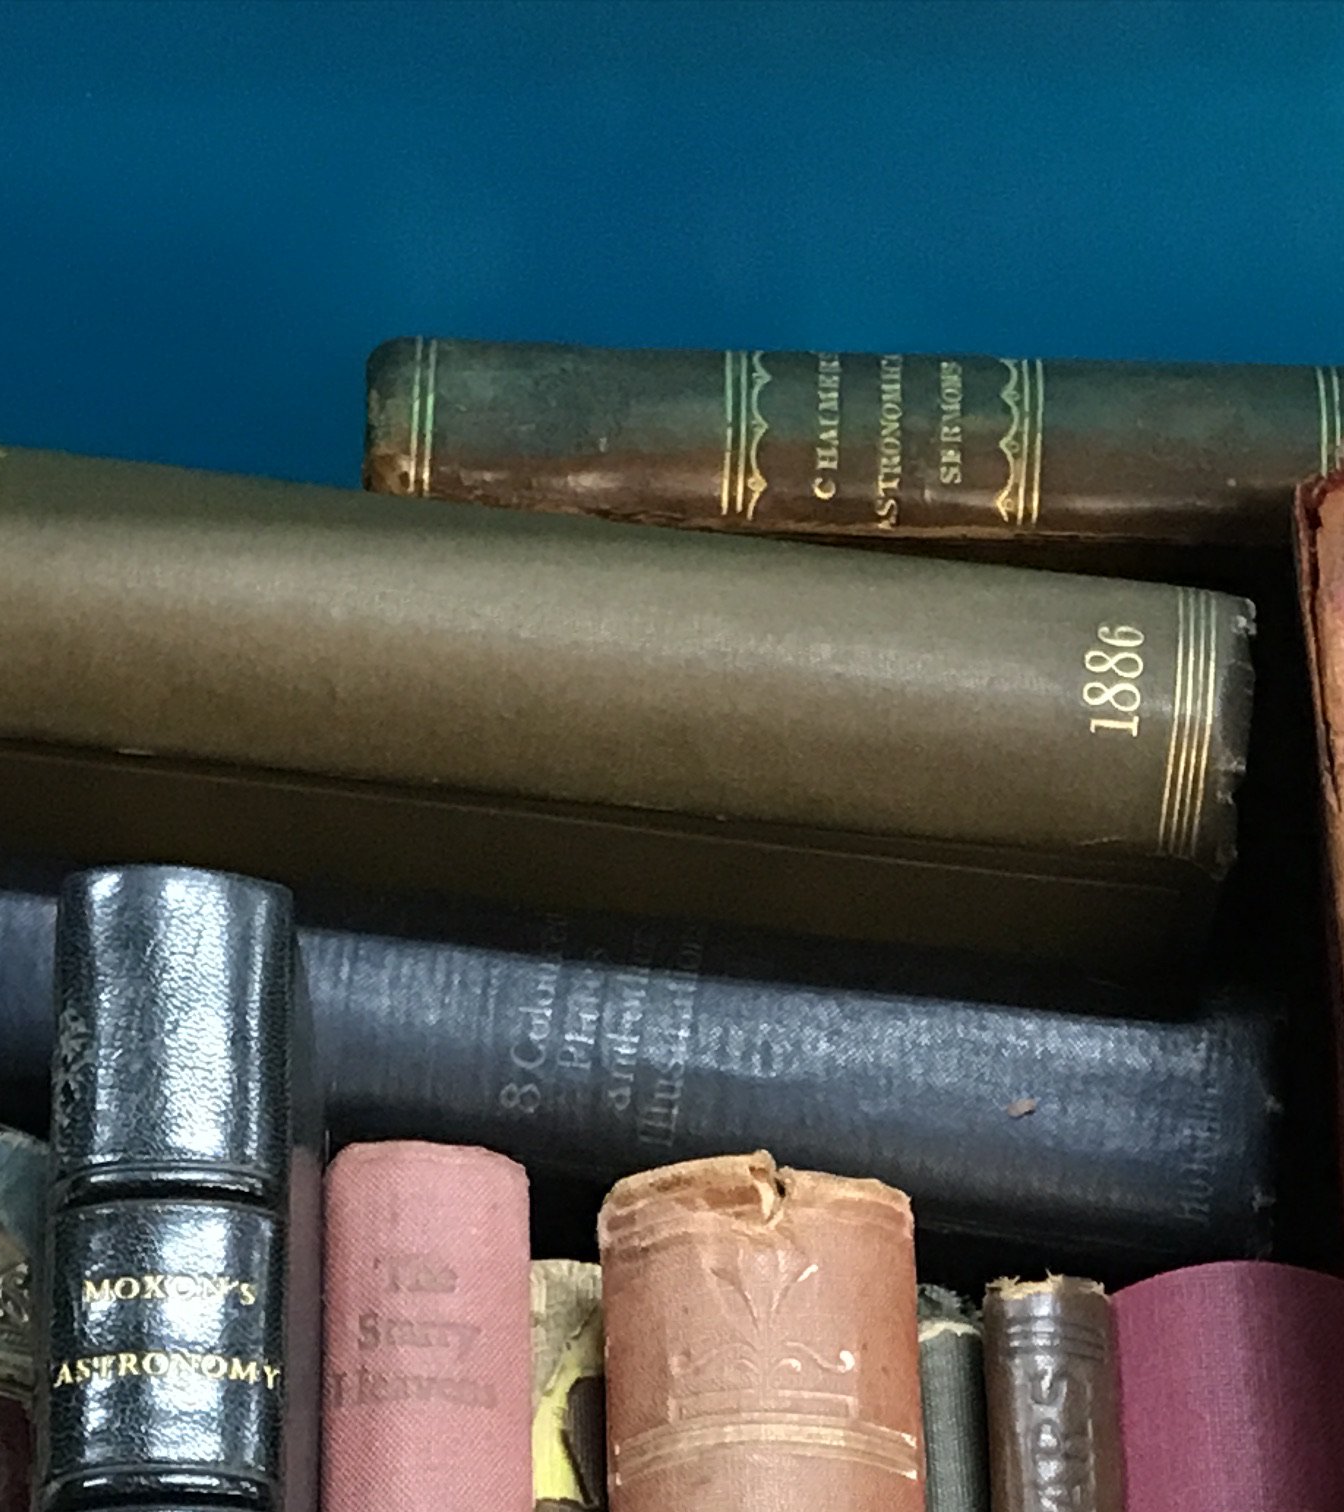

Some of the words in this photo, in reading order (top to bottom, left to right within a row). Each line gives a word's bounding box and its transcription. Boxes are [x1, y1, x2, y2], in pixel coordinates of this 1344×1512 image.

[939, 360, 964, 485] SERMONS
[1082, 625, 1146, 738] 1886
[500, 1083, 541, 1115] 8
[82, 1274, 257, 1306] MOXON'S
[53, 1351, 282, 1390] ASTRONOMY
